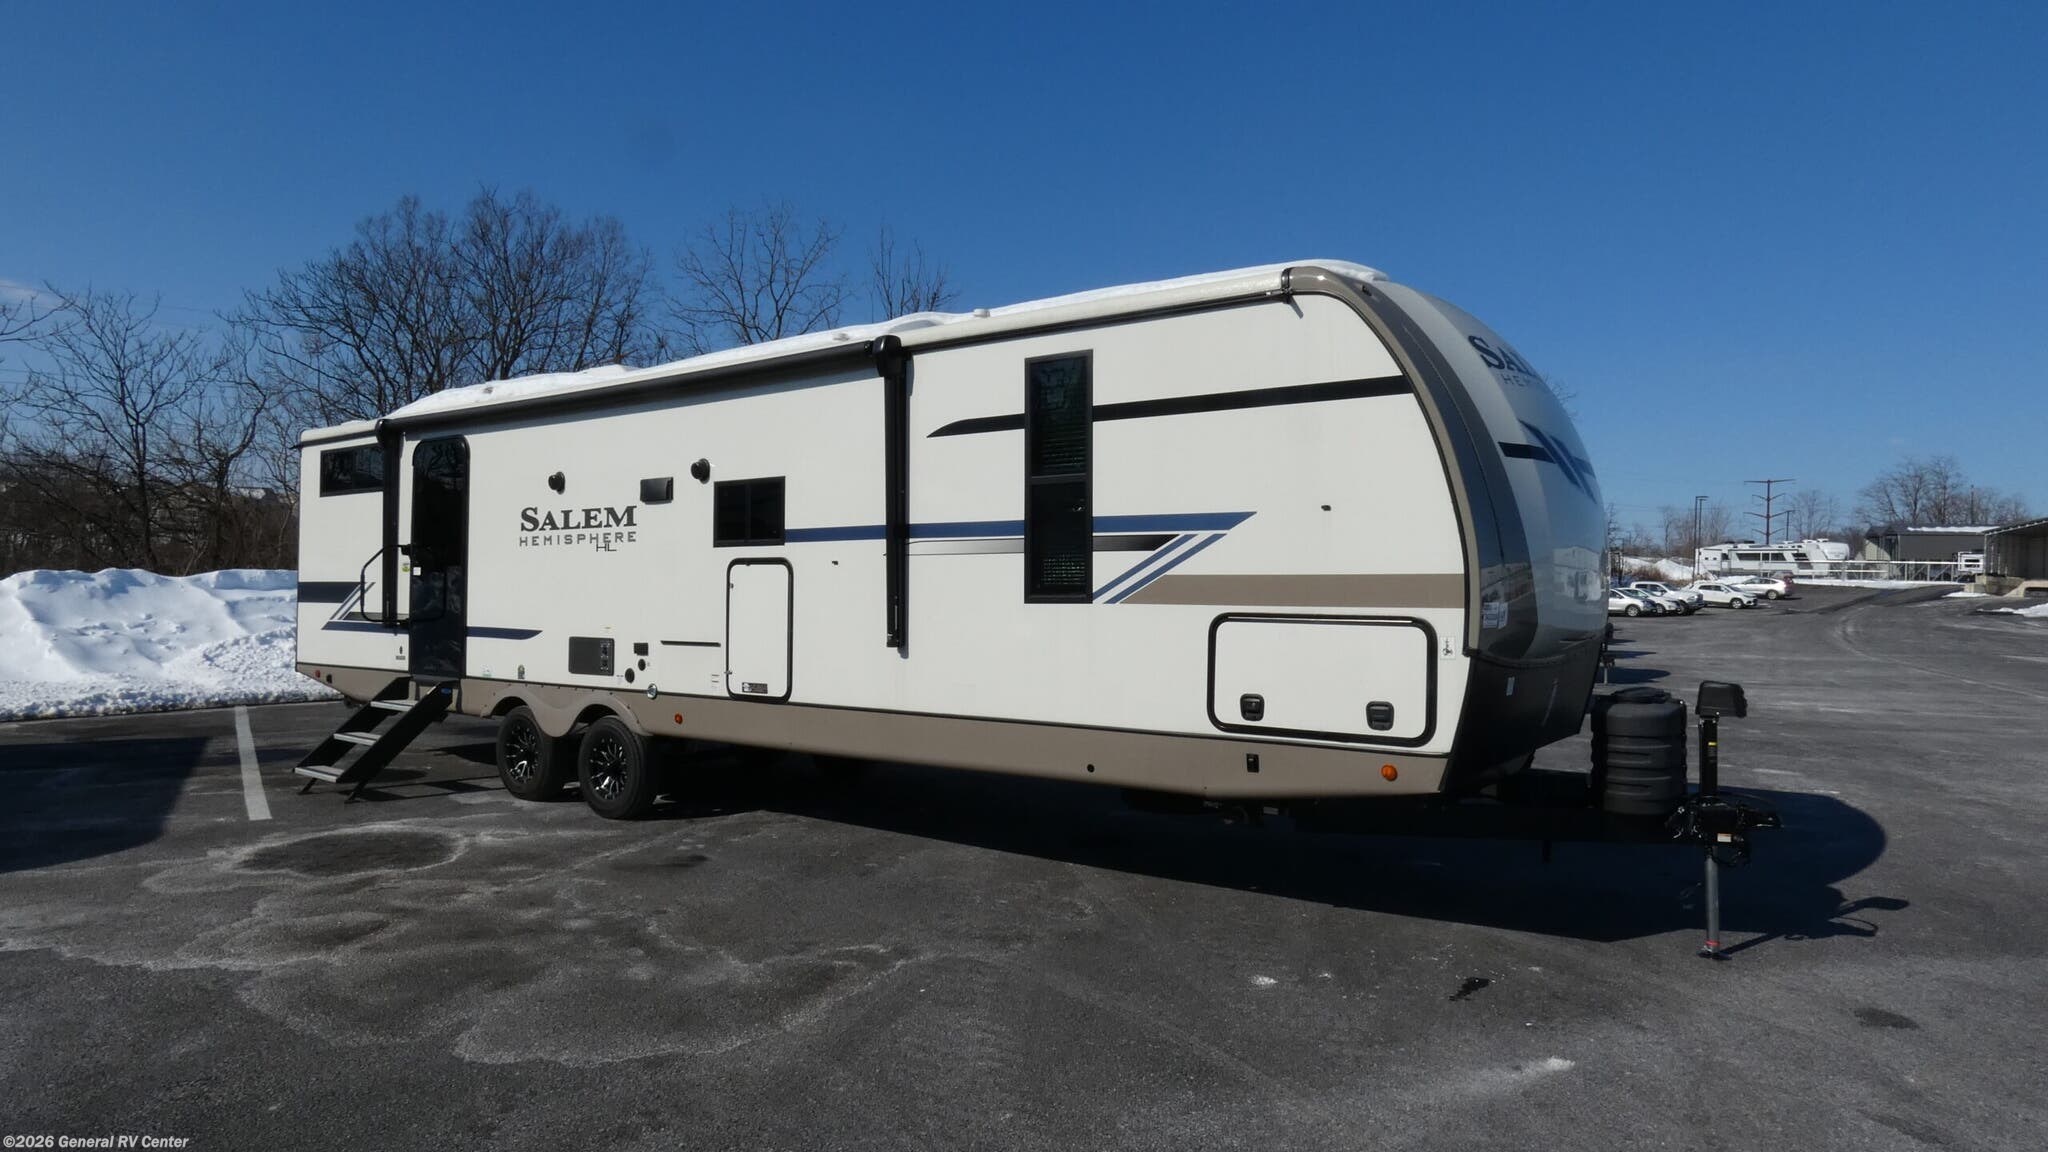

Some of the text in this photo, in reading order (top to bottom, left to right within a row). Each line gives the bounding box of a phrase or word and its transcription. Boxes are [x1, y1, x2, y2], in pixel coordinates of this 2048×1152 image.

[520, 506, 637, 532] SALEM
[519, 531, 637, 547] HEMISPHERE
[596, 542, 617, 552] HL
